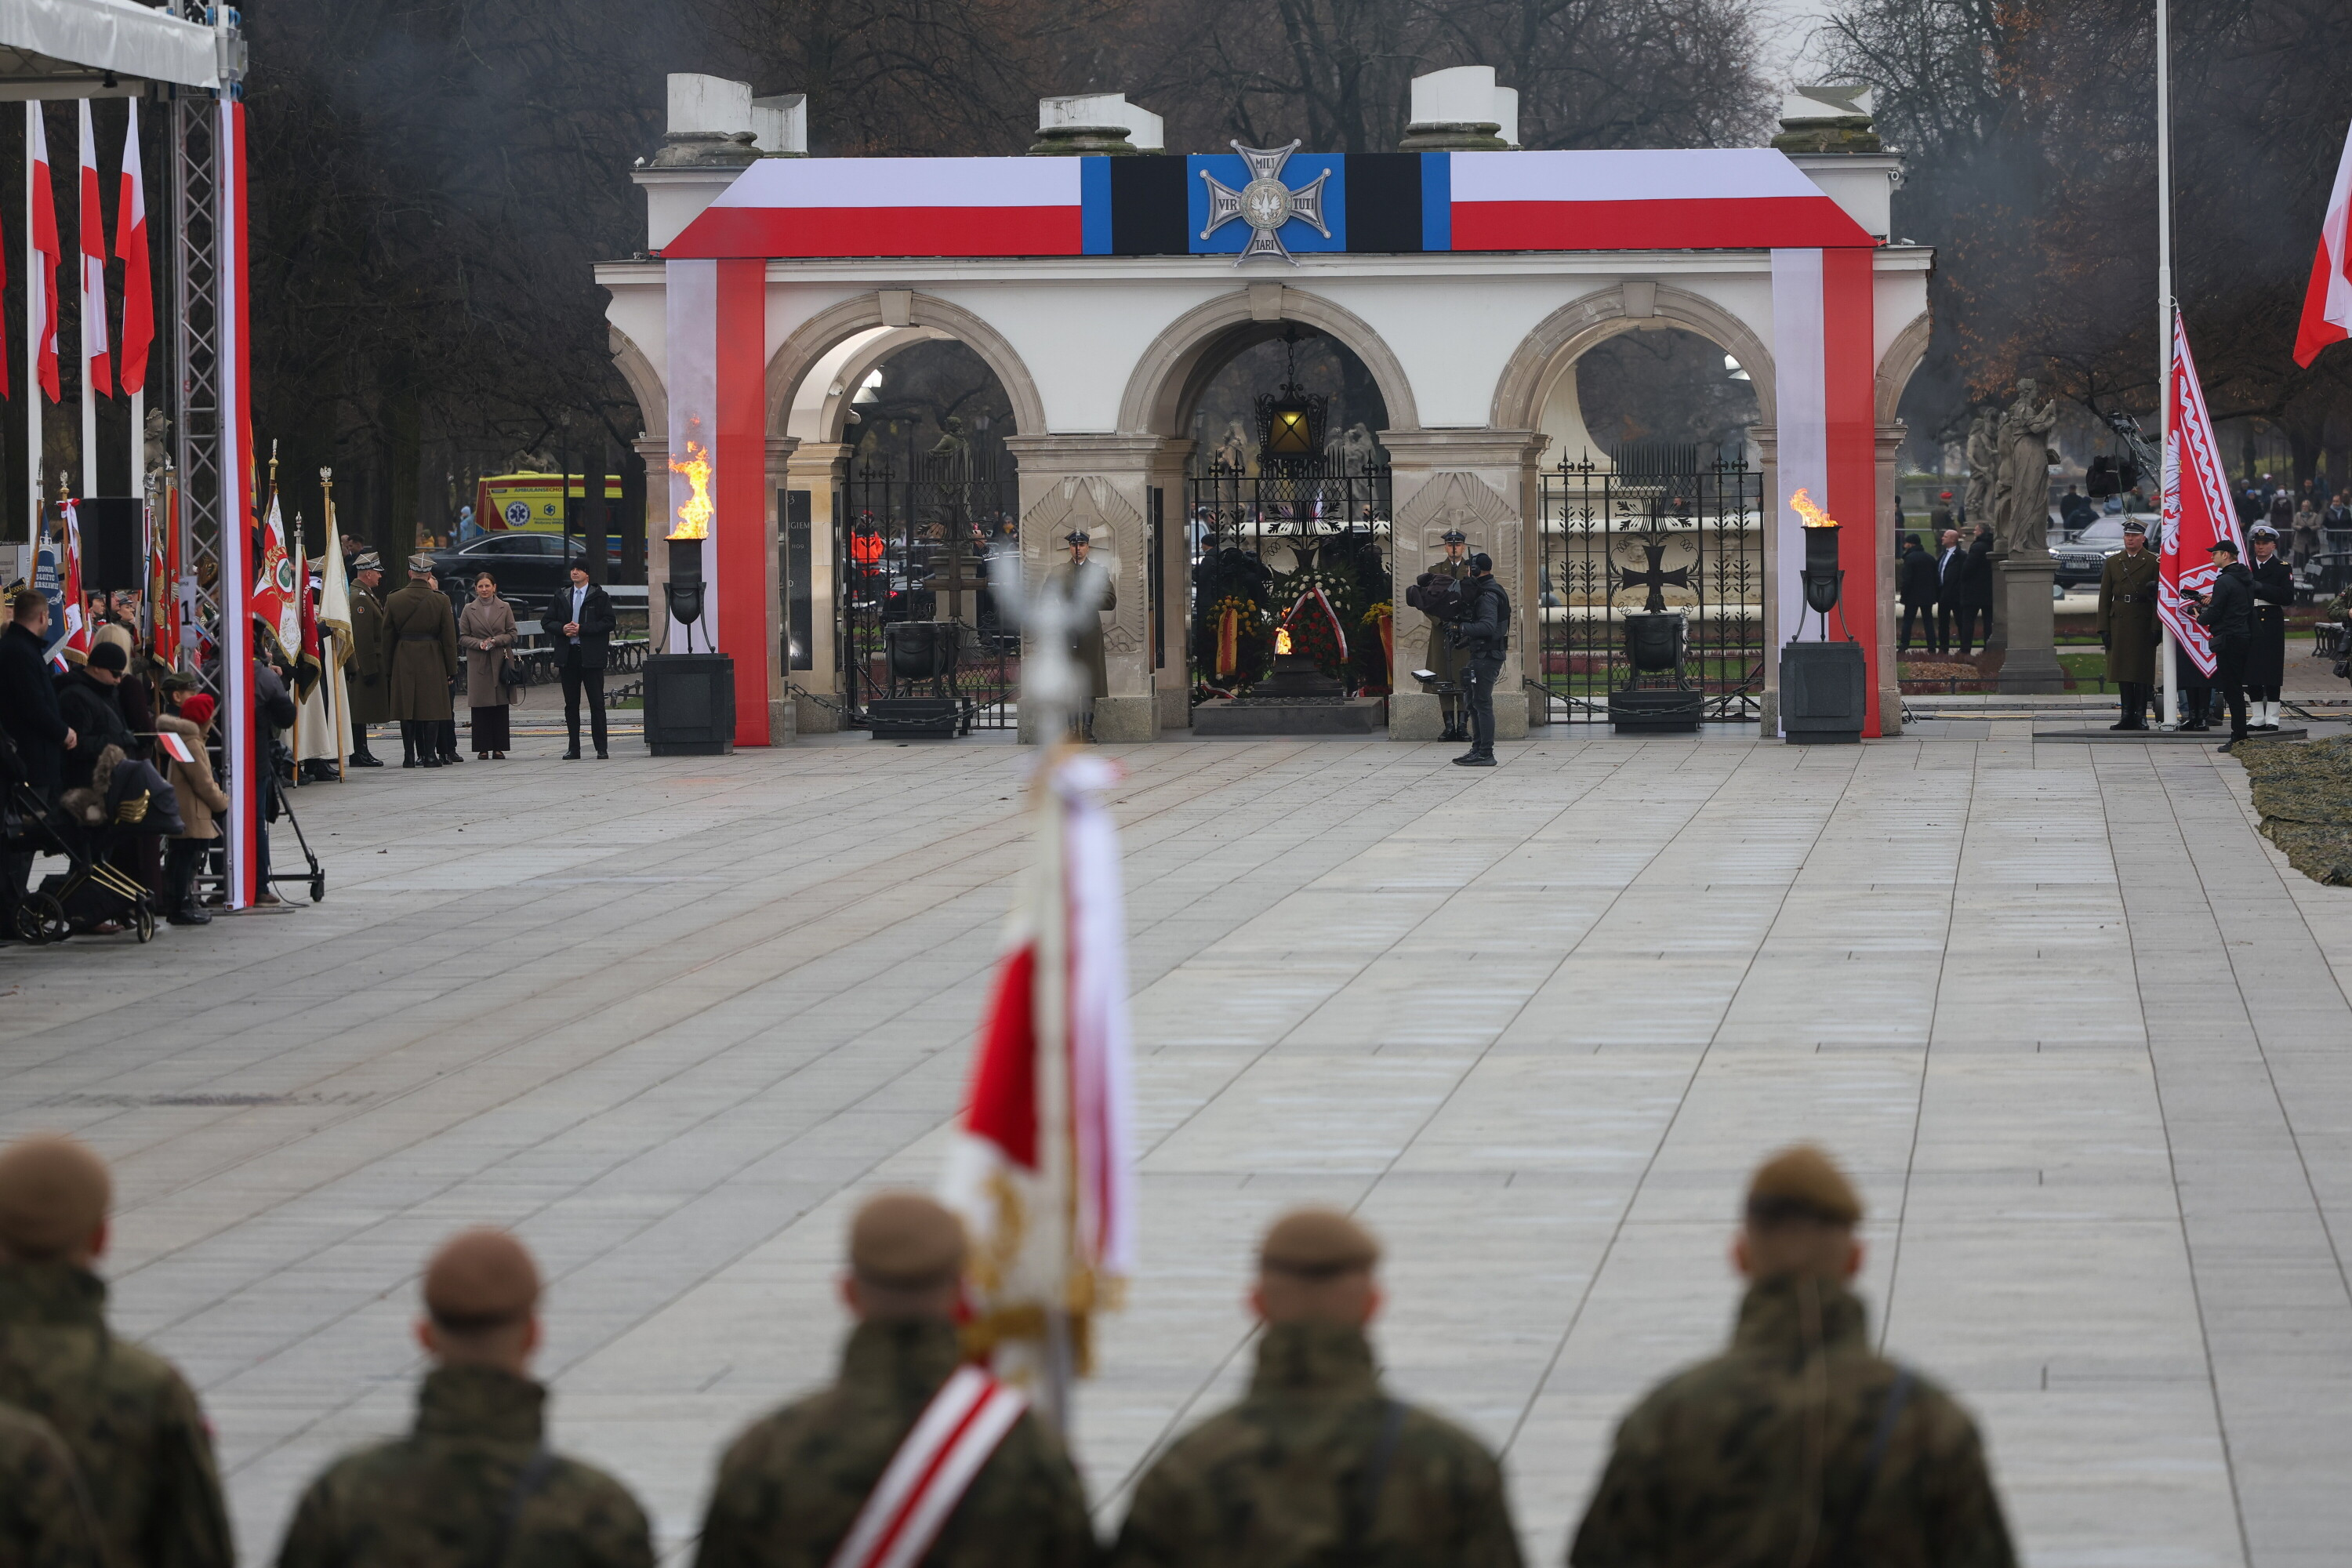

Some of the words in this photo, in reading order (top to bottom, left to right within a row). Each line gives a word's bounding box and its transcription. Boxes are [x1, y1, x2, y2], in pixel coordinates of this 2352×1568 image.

[1255, 158, 1275, 169] MILI
[1218, 198, 1237, 211] VIR
[1294, 198, 1315, 210] TUTI
[1255, 239, 1274, 251] TARI
[37, 565, 54, 574] HONOR
[34, 581, 59, 590] ARSZAWIE
[181, 600, 193, 626] 1
